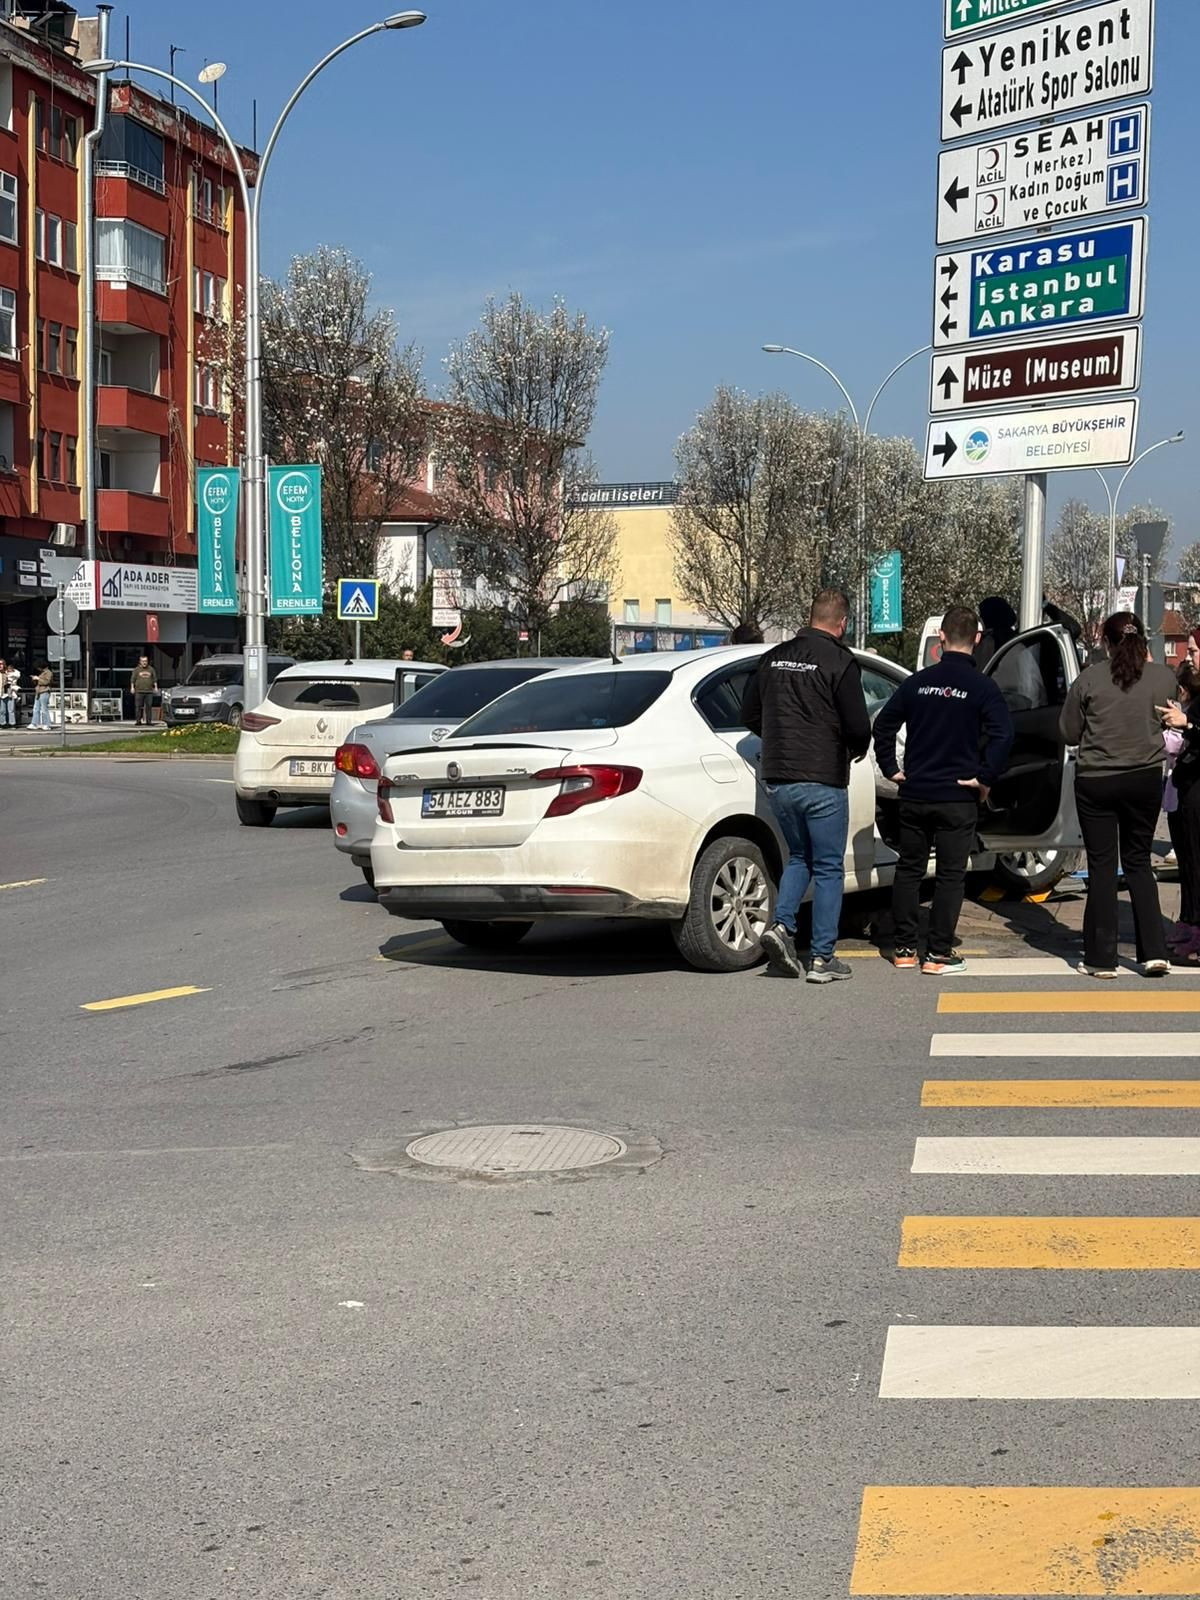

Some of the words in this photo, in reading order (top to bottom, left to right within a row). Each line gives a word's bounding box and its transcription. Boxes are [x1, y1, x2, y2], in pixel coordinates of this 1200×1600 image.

[979, 8, 1131, 77] Yenikent
[977, 76, 1035, 121] Atatürk
[1041, 69, 1077, 110] Spor
[1084, 55, 1140, 93] Salonu
[1013, 119, 1103, 158] SEAH
[1114, 119, 1134, 152] H
[979, 170, 1004, 184] ACİL
[1010, 181, 1049, 201] Kadın
[1056, 169, 1104, 192] Doğum
[1113, 166, 1133, 199] H
[1023, 205, 1039, 222] ve
[1045, 195, 1088, 220] Çocuk
[977, 215, 1003, 229] ACİL
[975, 240, 1095, 277] Karasu
[979, 264, 1117, 306] İstanbul
[977, 297, 1094, 330] Ankara
[967, 365, 1012, 391] Müze
[1025, 346, 1119, 386] (Museum)
[997, 425, 1049, 439] SAKARYA
[1052, 416, 1126, 435] BÜYÜKŞEHİR
[1026, 441, 1091, 457] BELEDİYESİ
[208, 487, 227, 496] EFEM
[283, 485, 308, 495] EFEM
[613, 487, 664, 502] liseleri
[213, 517, 222, 592] BELLONA
[290, 516, 302, 593] BELLONA
[123, 570, 143, 582] ADA
[145, 572, 170, 584] ADER
[203, 598, 235, 607] ERENLER
[277, 599, 318, 608] ERENLER
[771, 660, 797, 669] ELECTRO
[296, 762, 305, 772] 16
[311, 762, 328, 773] BKY
[430, 791, 444, 808] 54
[447, 790, 473, 808] AEZ
[475, 789, 501, 807] 883
